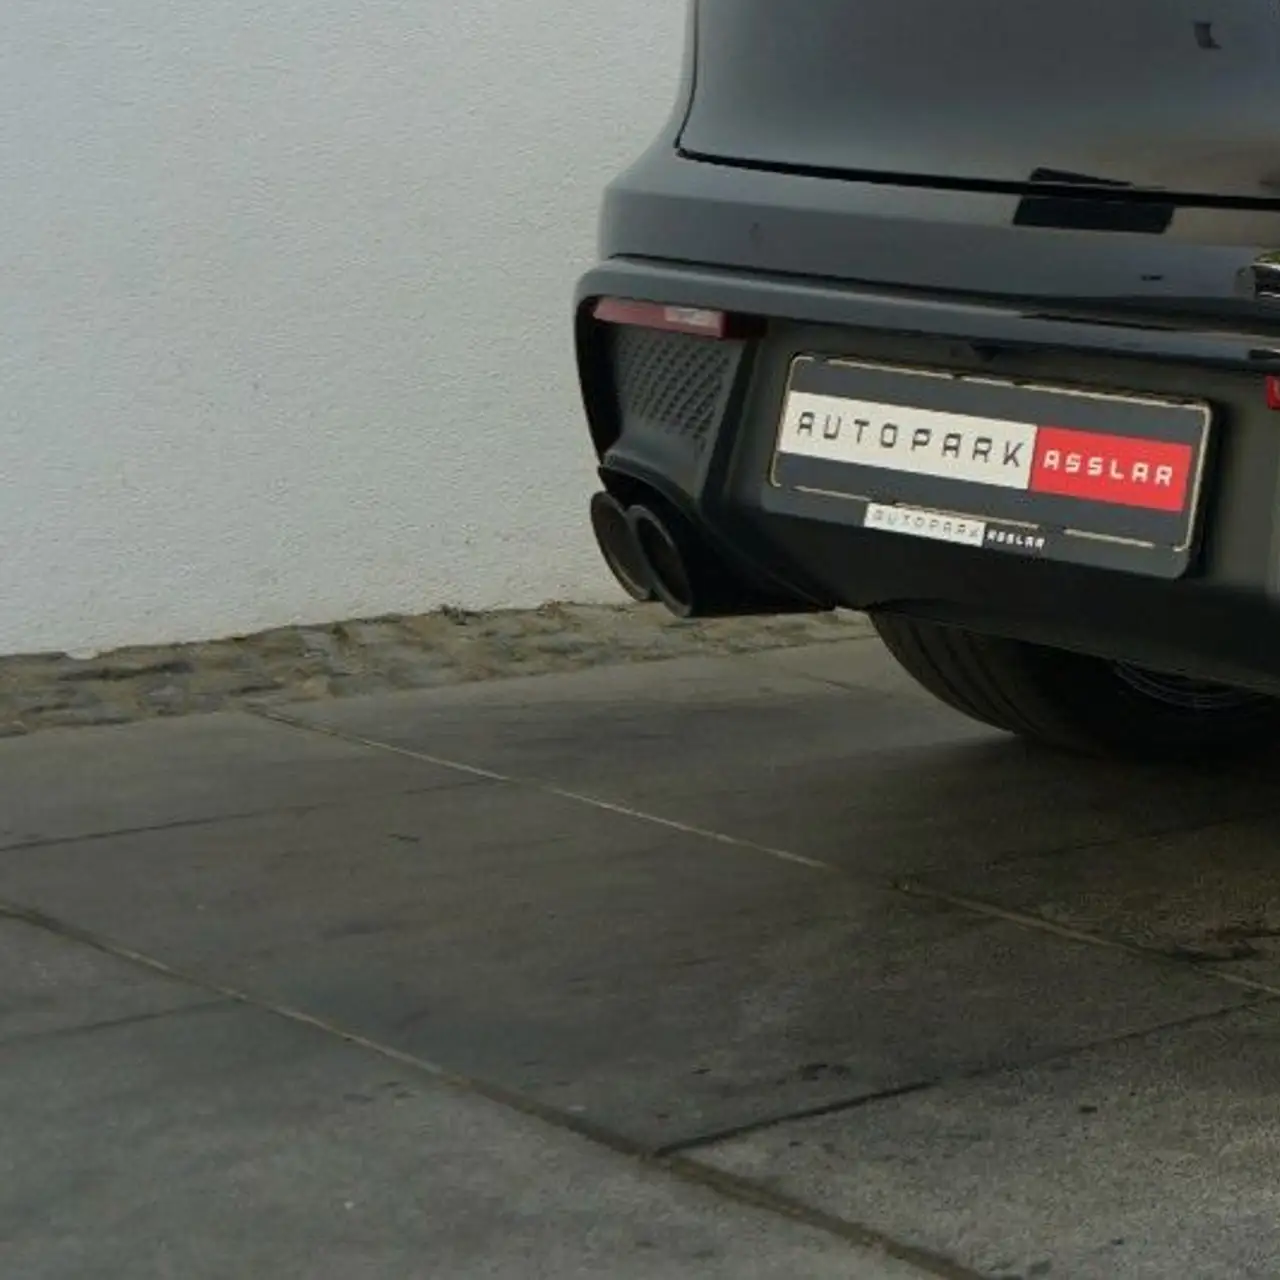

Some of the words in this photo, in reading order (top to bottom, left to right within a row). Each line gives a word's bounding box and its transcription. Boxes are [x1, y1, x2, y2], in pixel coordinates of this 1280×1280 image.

[797, 411, 1024, 468] AUTOPARK
[1043, 449, 1173, 486] ASSLAR
[874, 509, 981, 537] AUTOPARK
[986, 528, 1045, 549] ASSLAR
